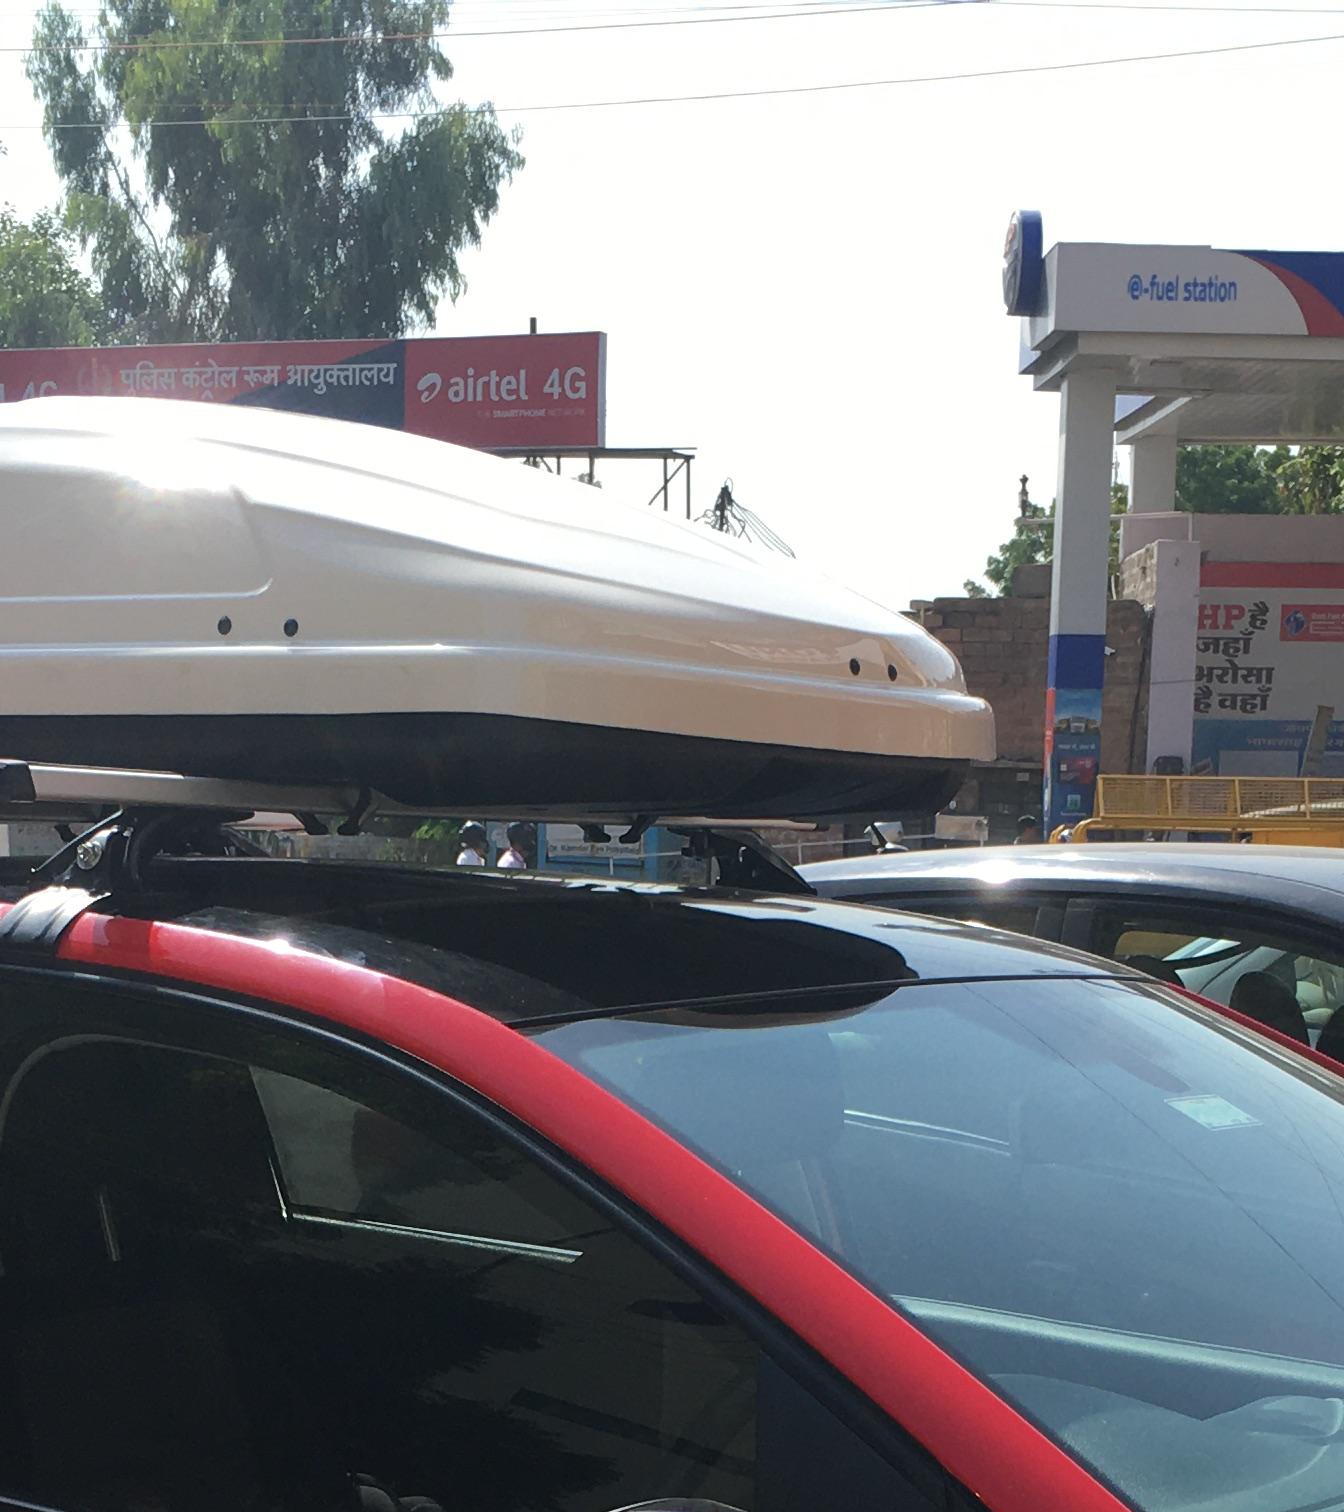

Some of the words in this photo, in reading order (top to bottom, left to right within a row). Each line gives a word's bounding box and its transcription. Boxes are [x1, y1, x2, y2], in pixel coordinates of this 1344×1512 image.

[1183, 274, 1237, 303] station
[242, 365, 281, 388] रूम
[448, 367, 528, 403] airtel
[543, 366, 587, 400] 4G
[1197, 604, 1246, 630] HP
[1248, 601, 1270, 630] है
[1195, 659, 1275, 684] भरोसा
